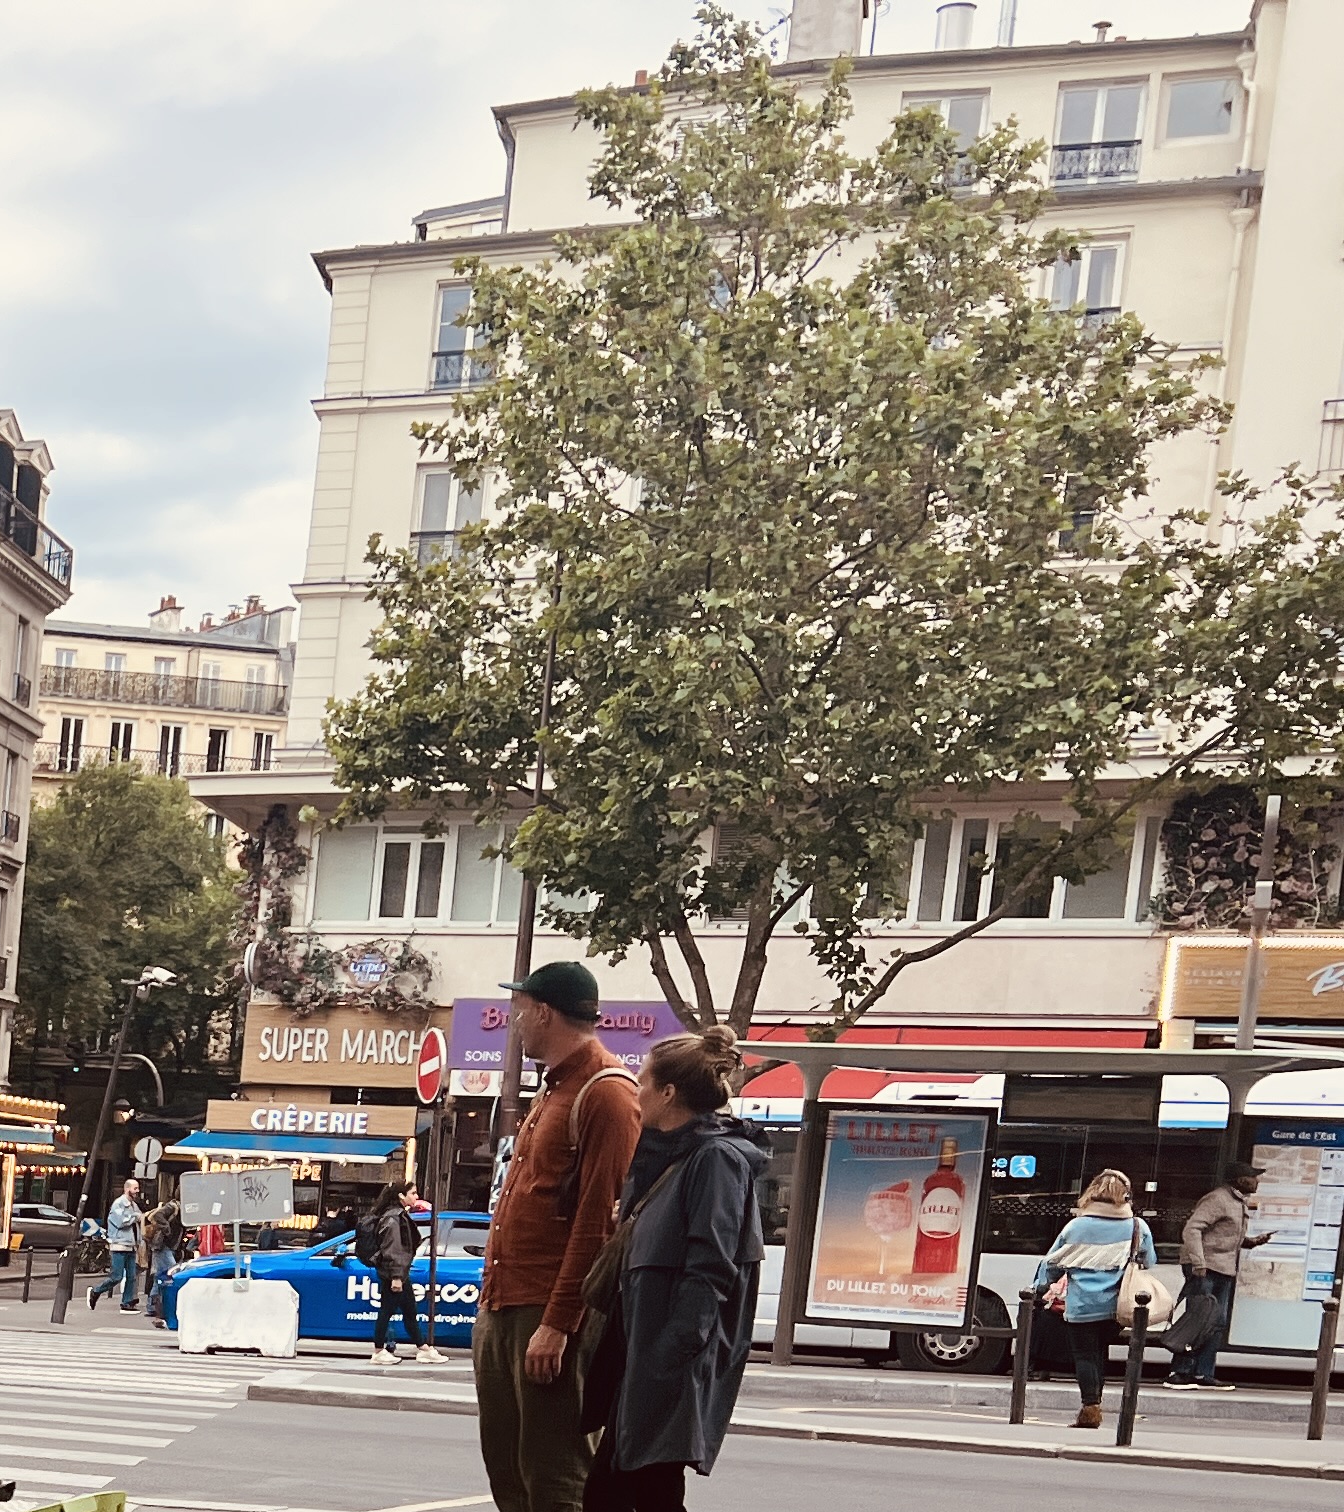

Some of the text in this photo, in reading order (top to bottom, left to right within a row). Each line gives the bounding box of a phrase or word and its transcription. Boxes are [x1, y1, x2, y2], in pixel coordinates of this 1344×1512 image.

[258, 1026, 425, 1065] SUPER MARCH
[464, 1051, 502, 1062] SOINS
[250, 1104, 368, 1134] CRÊPERIE
[847, 1120, 941, 1143] LILLET
[1272, 1130, 1296, 1139] Gare
[1298, 1131, 1311, 1139] de
[923, 1205, 960, 1216] LILLET
[827, 1279, 845, 1292] DU
[890, 1283, 909, 1296] DU
[912, 1285, 953, 1298] TONIC
